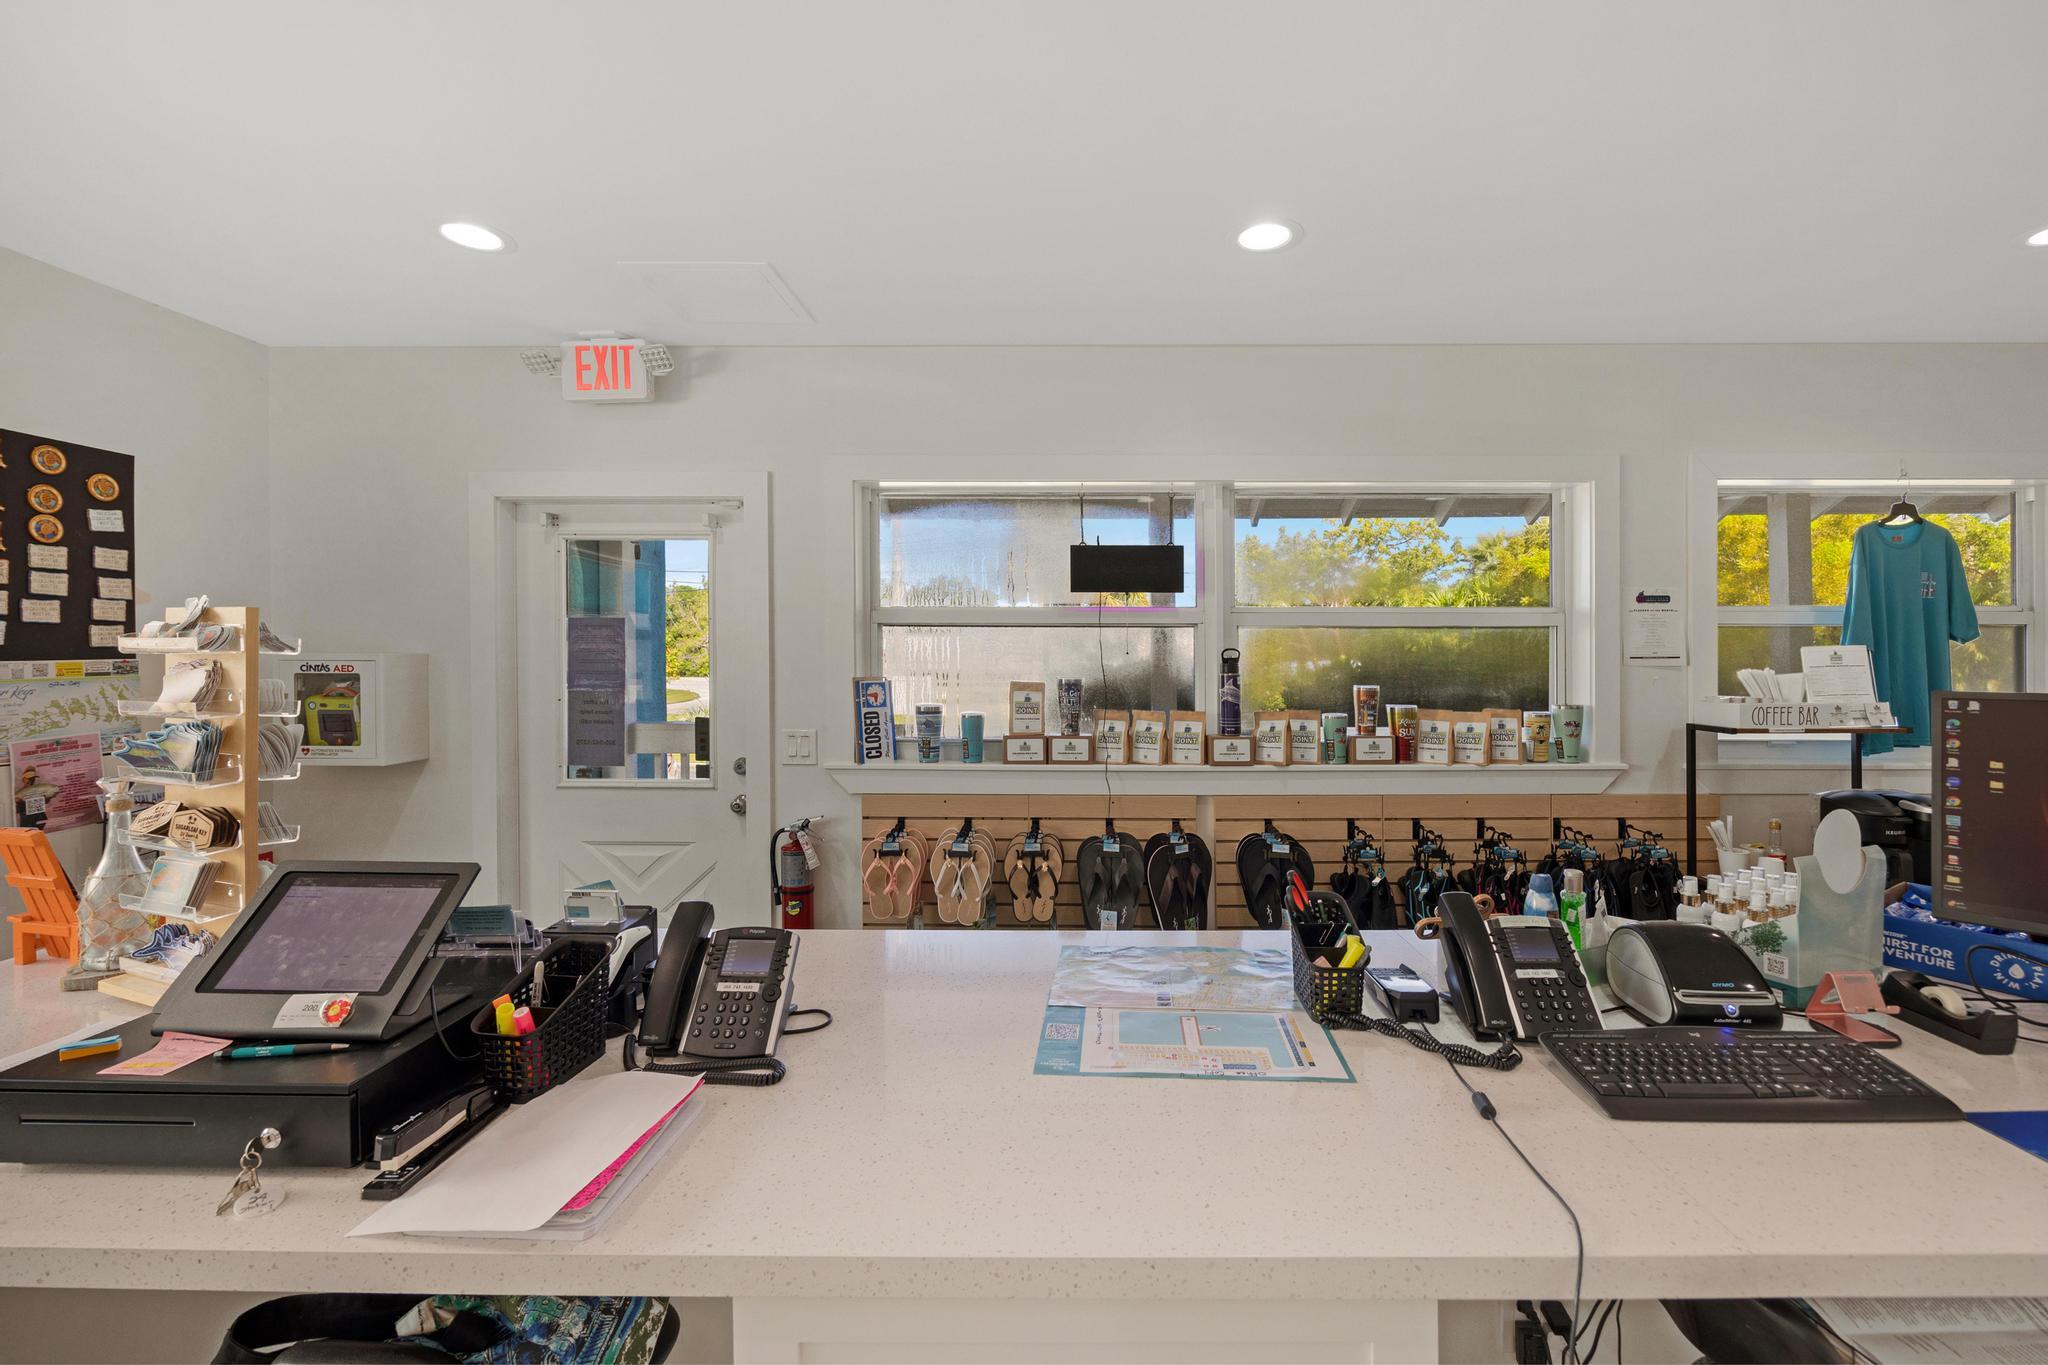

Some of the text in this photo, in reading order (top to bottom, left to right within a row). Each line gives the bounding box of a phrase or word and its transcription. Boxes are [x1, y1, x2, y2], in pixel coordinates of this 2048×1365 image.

[575, 345, 634, 391] EXIT
[333, 664, 355, 672] AED
[1016, 706, 1039, 715] JOINT
[1751, 705, 1819, 726] COFFEE BAR
[864, 711, 882, 760] CLOSED
[1259, 735, 1280, 743] JOINT
[1100, 736, 1120, 744] JOINT
[1136, 736, 1156, 744] JOINT
[1176, 737, 1197, 745] JOINT
[1292, 736, 1314, 744] JOINT
[1421, 737, 1444, 745] JOINT
[1457, 737, 1480, 745] JOINT
[175, 824, 198, 835] SUGARLOAF
[198, 828, 208, 837] KEY
[1921, 944, 1953, 959] FOR
